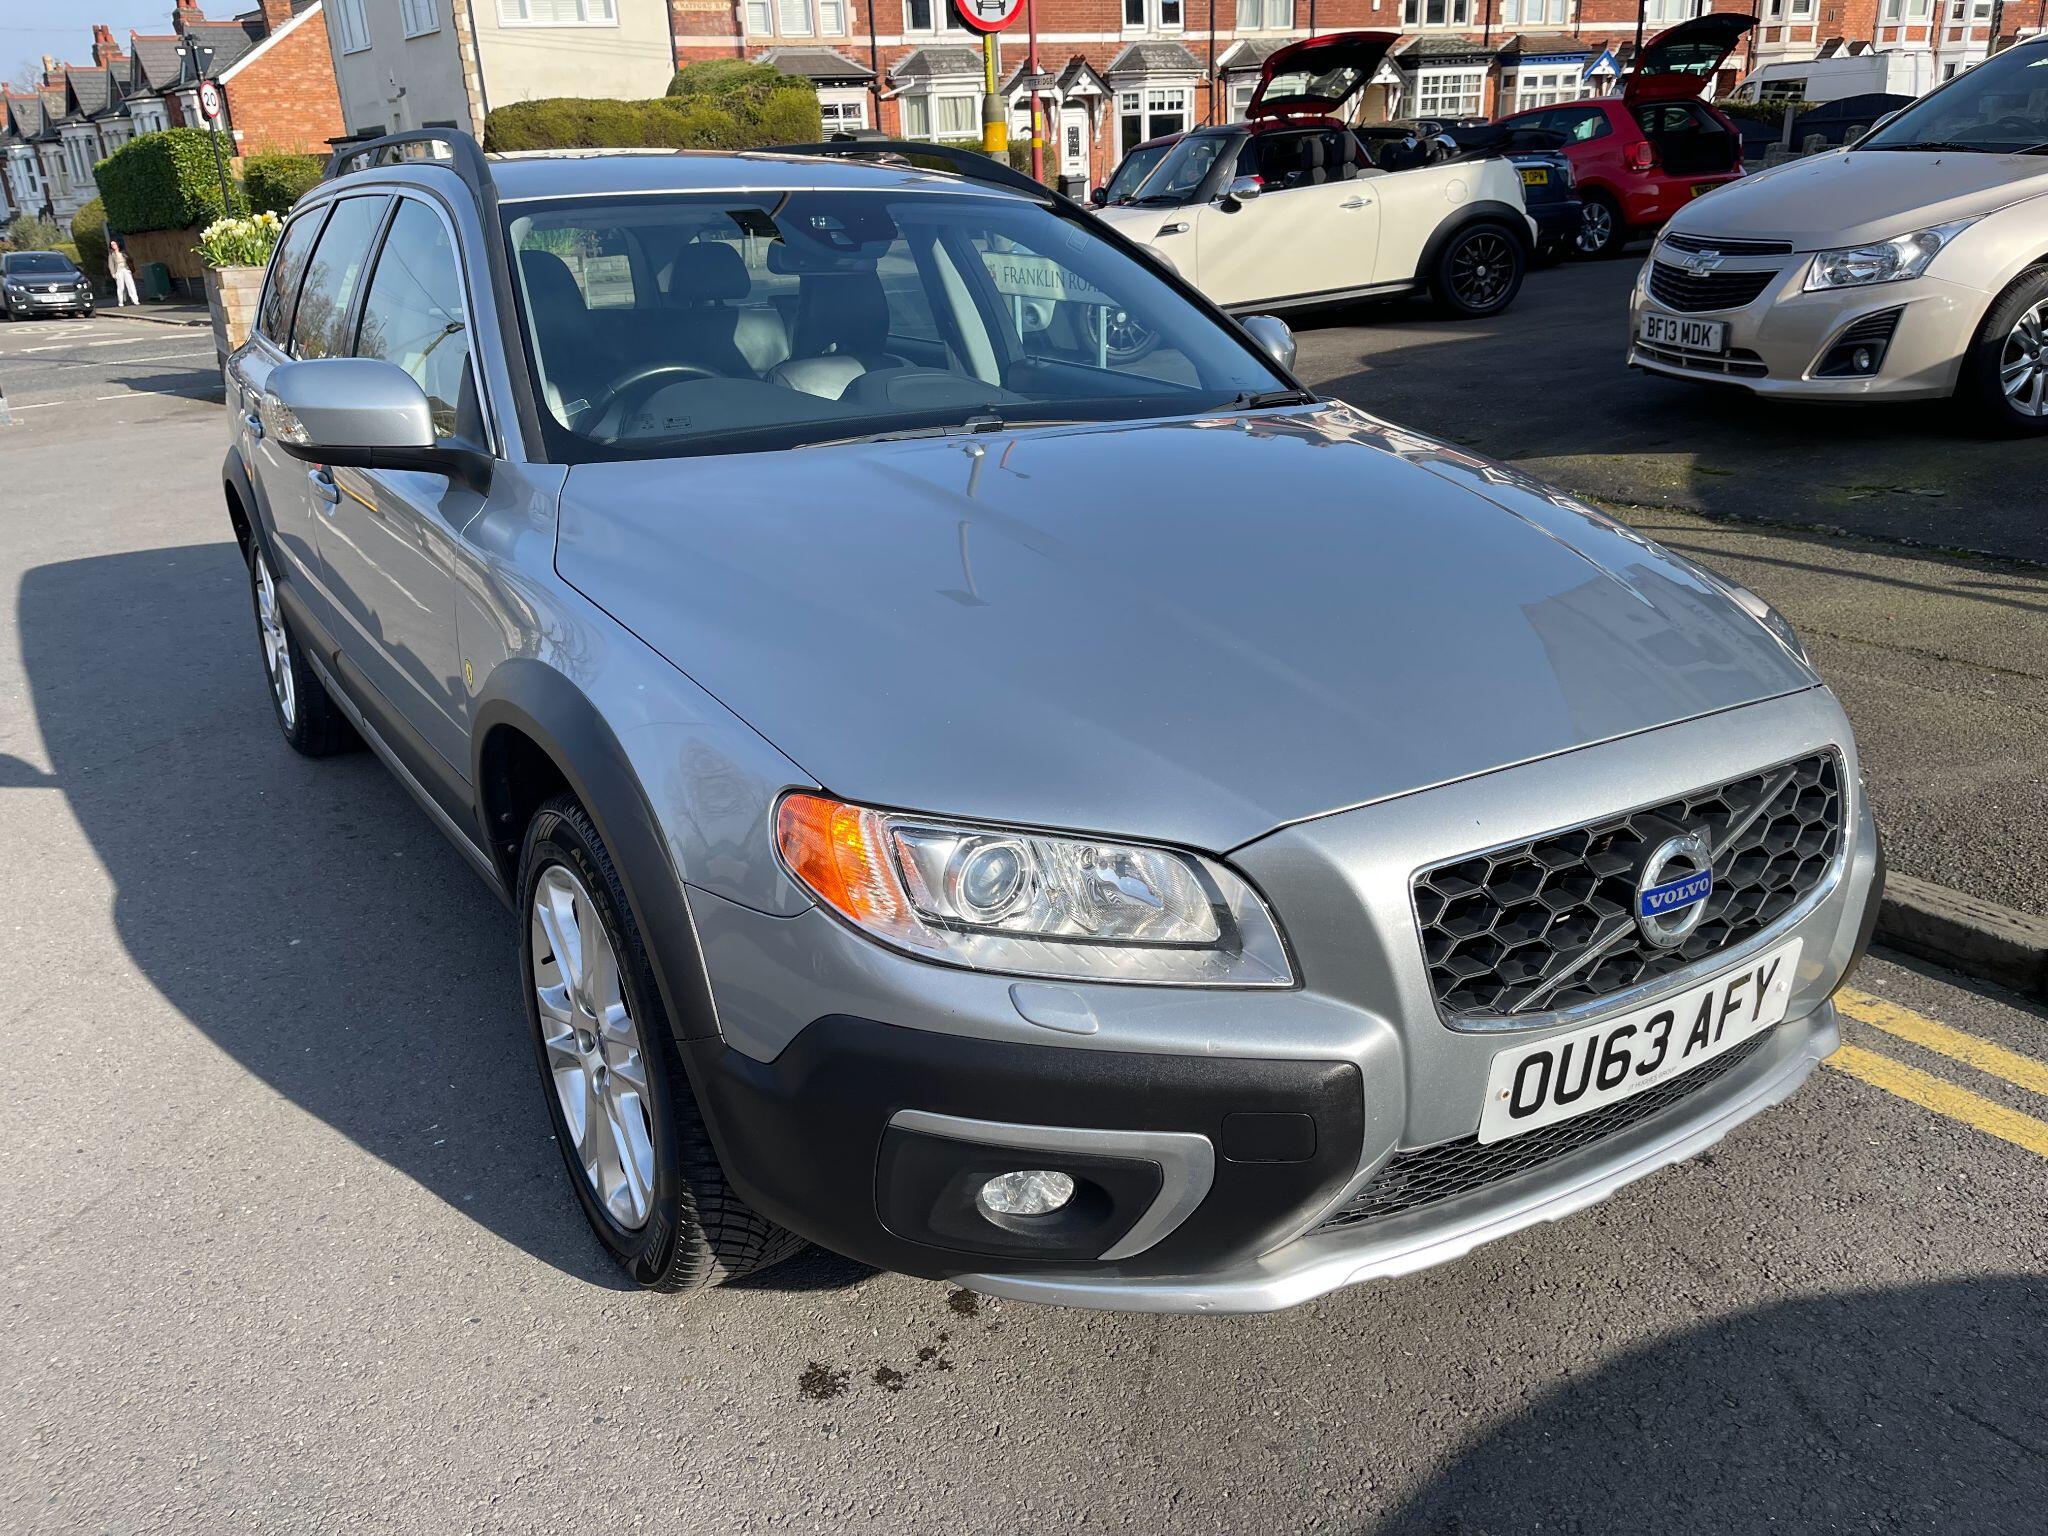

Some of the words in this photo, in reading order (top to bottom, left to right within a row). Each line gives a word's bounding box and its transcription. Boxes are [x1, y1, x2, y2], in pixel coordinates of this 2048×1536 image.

[204, 92, 216, 106] 20
[1003, 266, 1065, 291] FRANKLIN
[1069, 273, 1100, 292] ROA
[1647, 317, 1677, 341] BF13
[1681, 321, 1712, 346] MDK
[571, 847, 595, 888] ALL
[1647, 878, 1709, 908] VOLVO
[1509, 1009, 1675, 1120] OU63
[1682, 957, 1781, 1060] AFY
